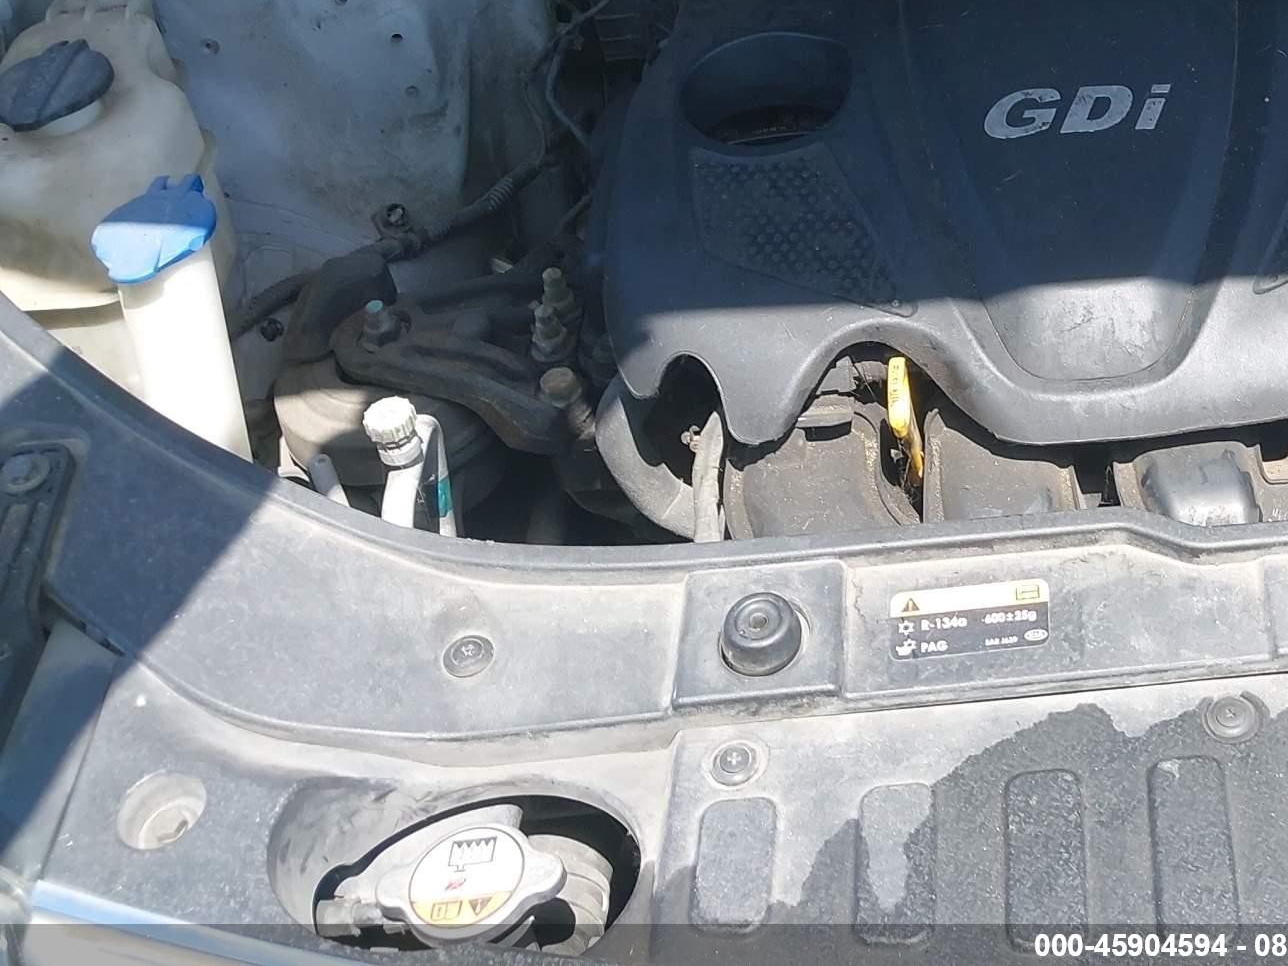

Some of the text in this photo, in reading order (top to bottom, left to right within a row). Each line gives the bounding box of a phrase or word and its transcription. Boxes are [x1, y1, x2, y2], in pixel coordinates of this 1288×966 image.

[984, 84, 1171, 139] GDi
[921, 616, 967, 631] R-134a
[920, 640, 949, 653] PAG
